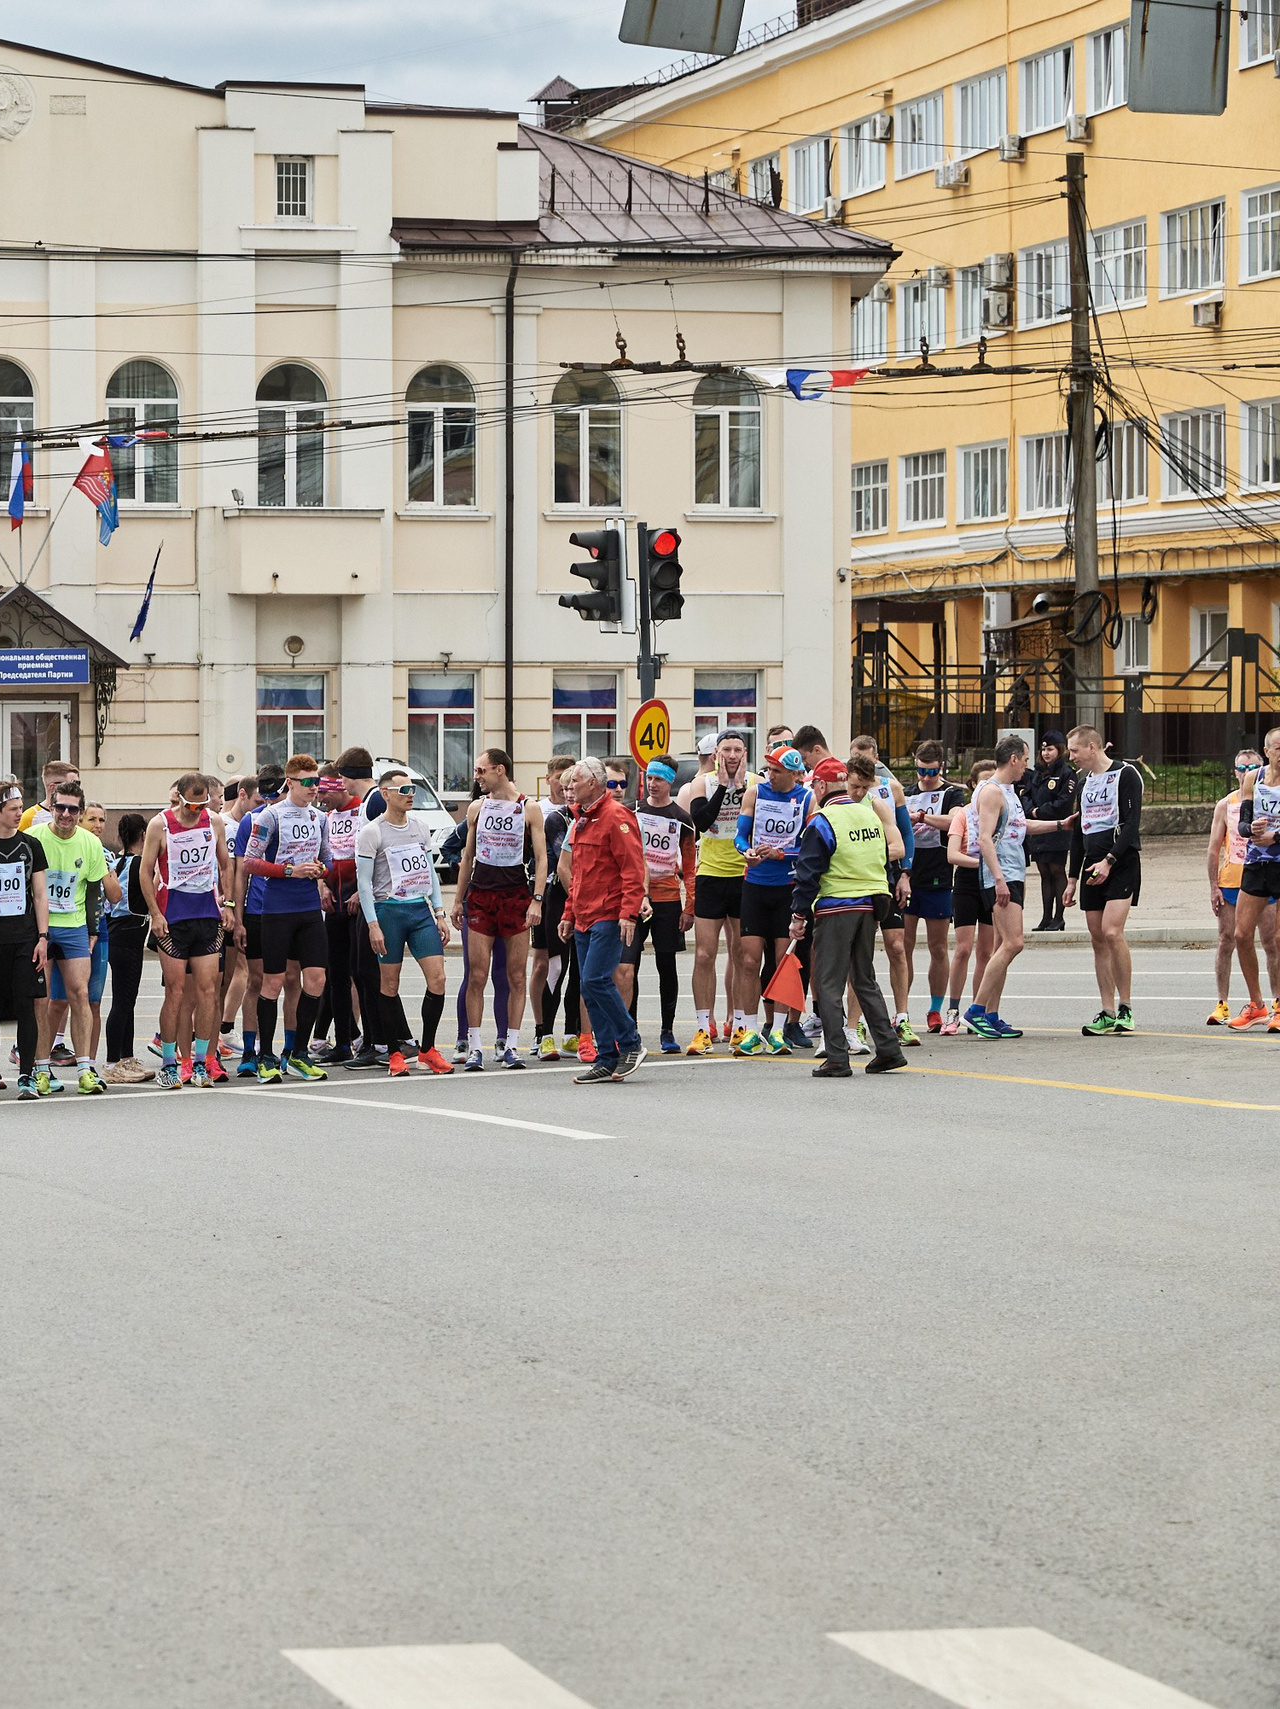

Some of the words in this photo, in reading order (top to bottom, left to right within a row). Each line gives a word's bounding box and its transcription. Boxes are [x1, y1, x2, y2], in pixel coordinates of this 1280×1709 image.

[35, 653, 86, 661] общественная
[47, 671, 74, 679] Партии
[639, 722, 666, 750] 40
[1261, 799, 1280, 813] 07
[765, 818, 796, 834] 060
[848, 828, 881, 842] СУДЬЯ
[180, 846, 209, 864] 037
[401, 854, 427, 872] 083
[48, 884, 71, 898] 196
